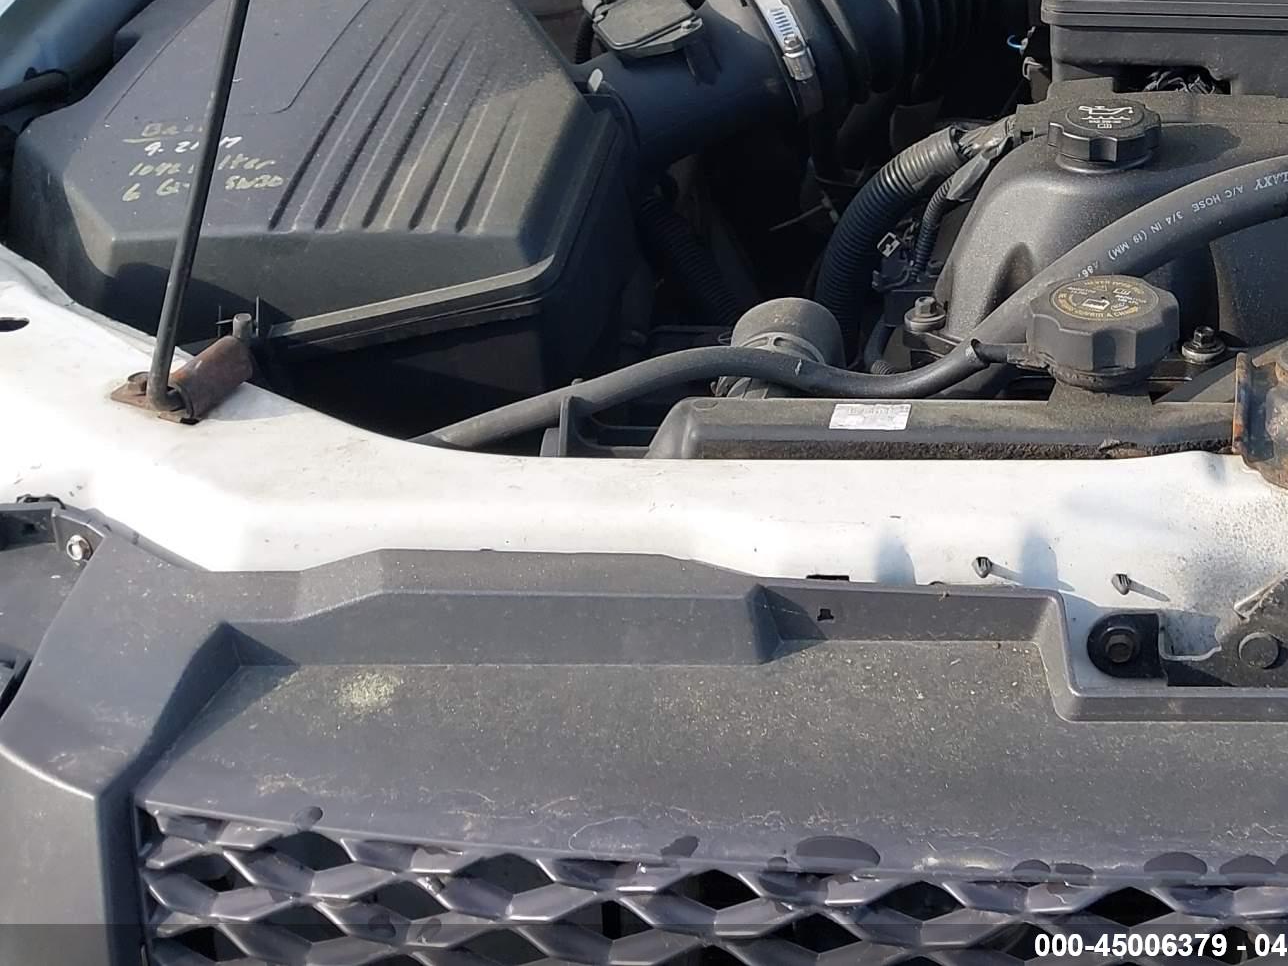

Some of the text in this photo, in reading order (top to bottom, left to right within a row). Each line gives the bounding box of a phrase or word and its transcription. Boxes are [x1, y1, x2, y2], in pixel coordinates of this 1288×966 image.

[1223, 184, 1244, 198] A/C
[1191, 194, 1222, 213] HOSE
[1166, 209, 1184, 227] 3/4
[1150, 220, 1163, 234] IN
[1132, 228, 1148, 244] (19
[1107, 241, 1130, 261] MM)
